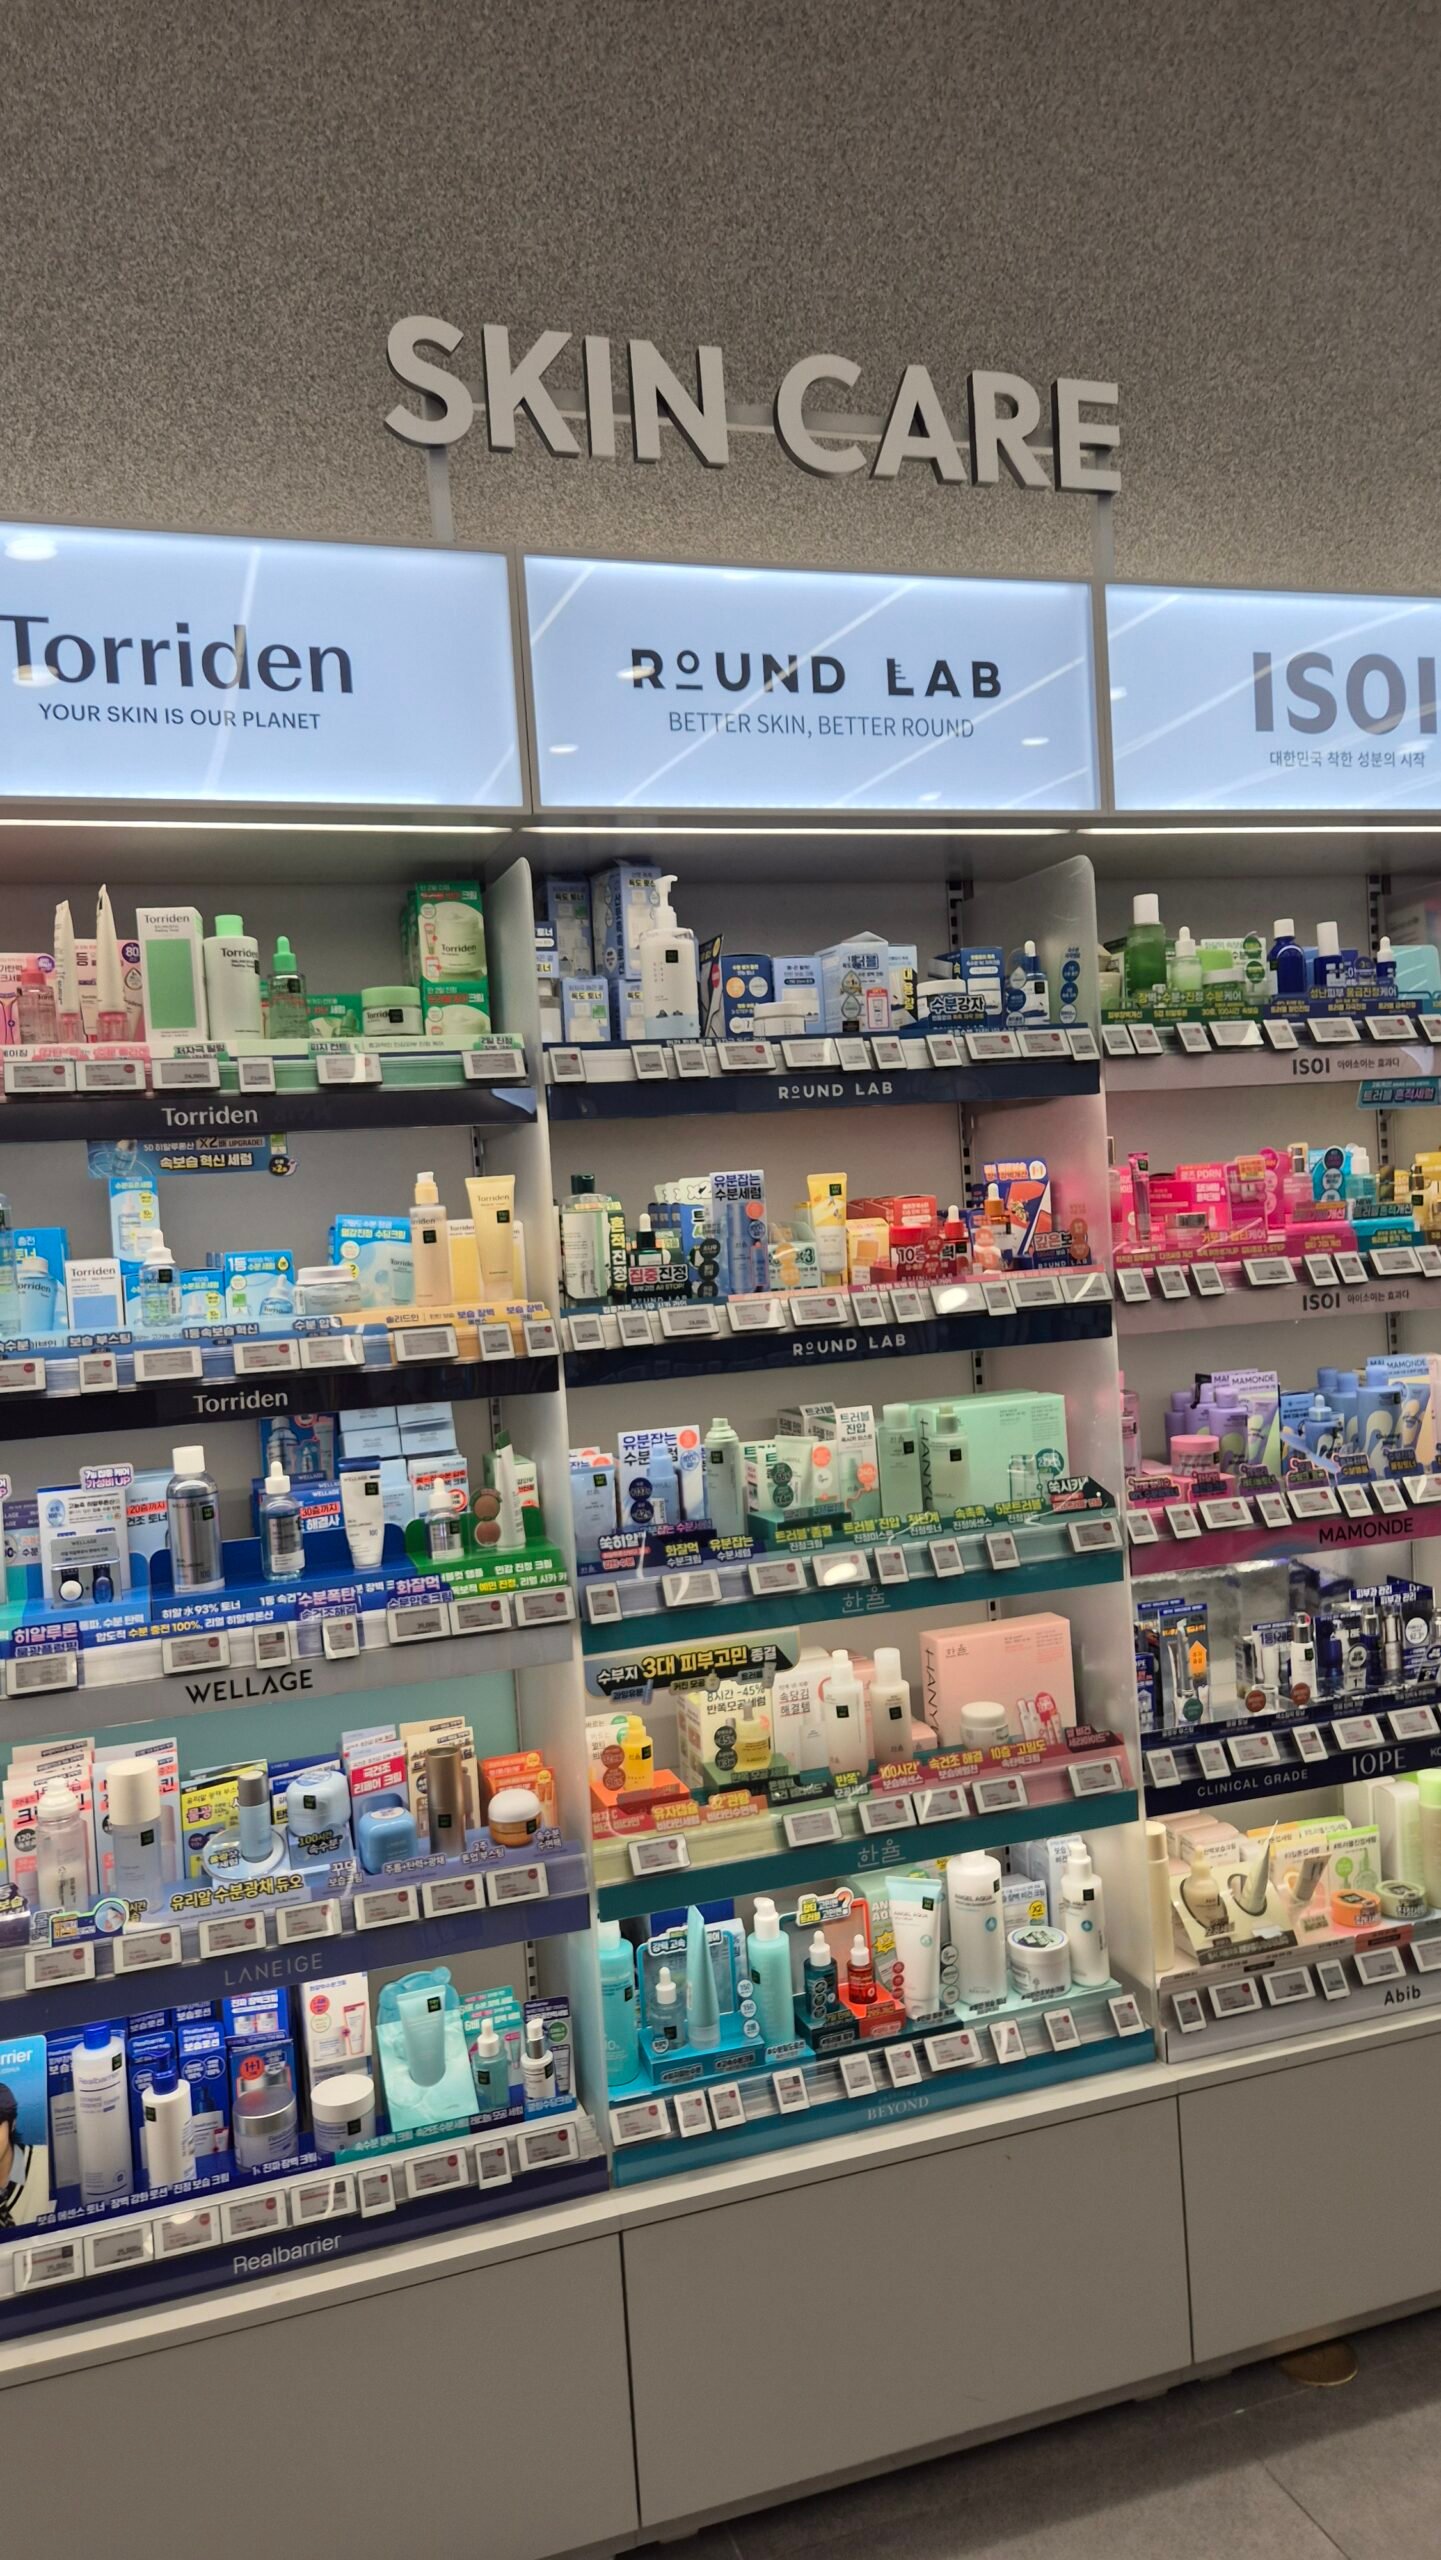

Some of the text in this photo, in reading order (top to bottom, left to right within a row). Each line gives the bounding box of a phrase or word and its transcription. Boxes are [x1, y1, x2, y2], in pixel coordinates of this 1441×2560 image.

[384, 315, 1122, 494] SKIN CARE
[0, 614, 354, 695] Torriden
[887, 657, 1001, 699] LAB
[1252, 650, 1438, 736] ISOI
[38, 702, 321, 730] YOUR SKIN IS OUR PLANET
[668, 710, 975, 739] BETTER SKIN, BETTER ROUND
[1270, 750, 1426, 769] 대한민국 착한 성분의 시작
[144, 914, 190, 925] Torriden
[1293, 1058, 1331, 1075] ISOI
[778, 1082, 894, 1099] ROUND LAB
[161, 1105, 259, 1127] Torriden
[714, 1173, 762, 1188] 유분잡는
[714, 1187, 763, 1201] 수분세럼
[71, 1266, 116, 1278] Torriden
[629, 1263, 688, 1285] 집중진정
[1302, 1292, 1341, 1311] ISOI
[792, 1333, 907, 1356] ROUND LAB
[1231, 1374, 1276, 1386] MAMONDE
[192, 1391, 289, 1414] Torriden
[840, 1411, 871, 1424] 트러블
[1318, 1517, 1414, 1544] MAMONDE
[597, 1644, 778, 1685] 수부지 3대 피부고민 종결
[186, 1669, 313, 1704] WELLAGE
[1352, 1748, 1407, 1777] IOPE
[1198, 1769, 1309, 1797] CLINICAL GRADE
[170, 1874, 304, 1912] 유리알 수분광채 듀오
[224, 1952, 324, 1986] LANEIGE
[1384, 1984, 1421, 2006] Abib
[867, 2097, 929, 2121] BEYOND
[233, 2235, 342, 2275] Realbarrier
